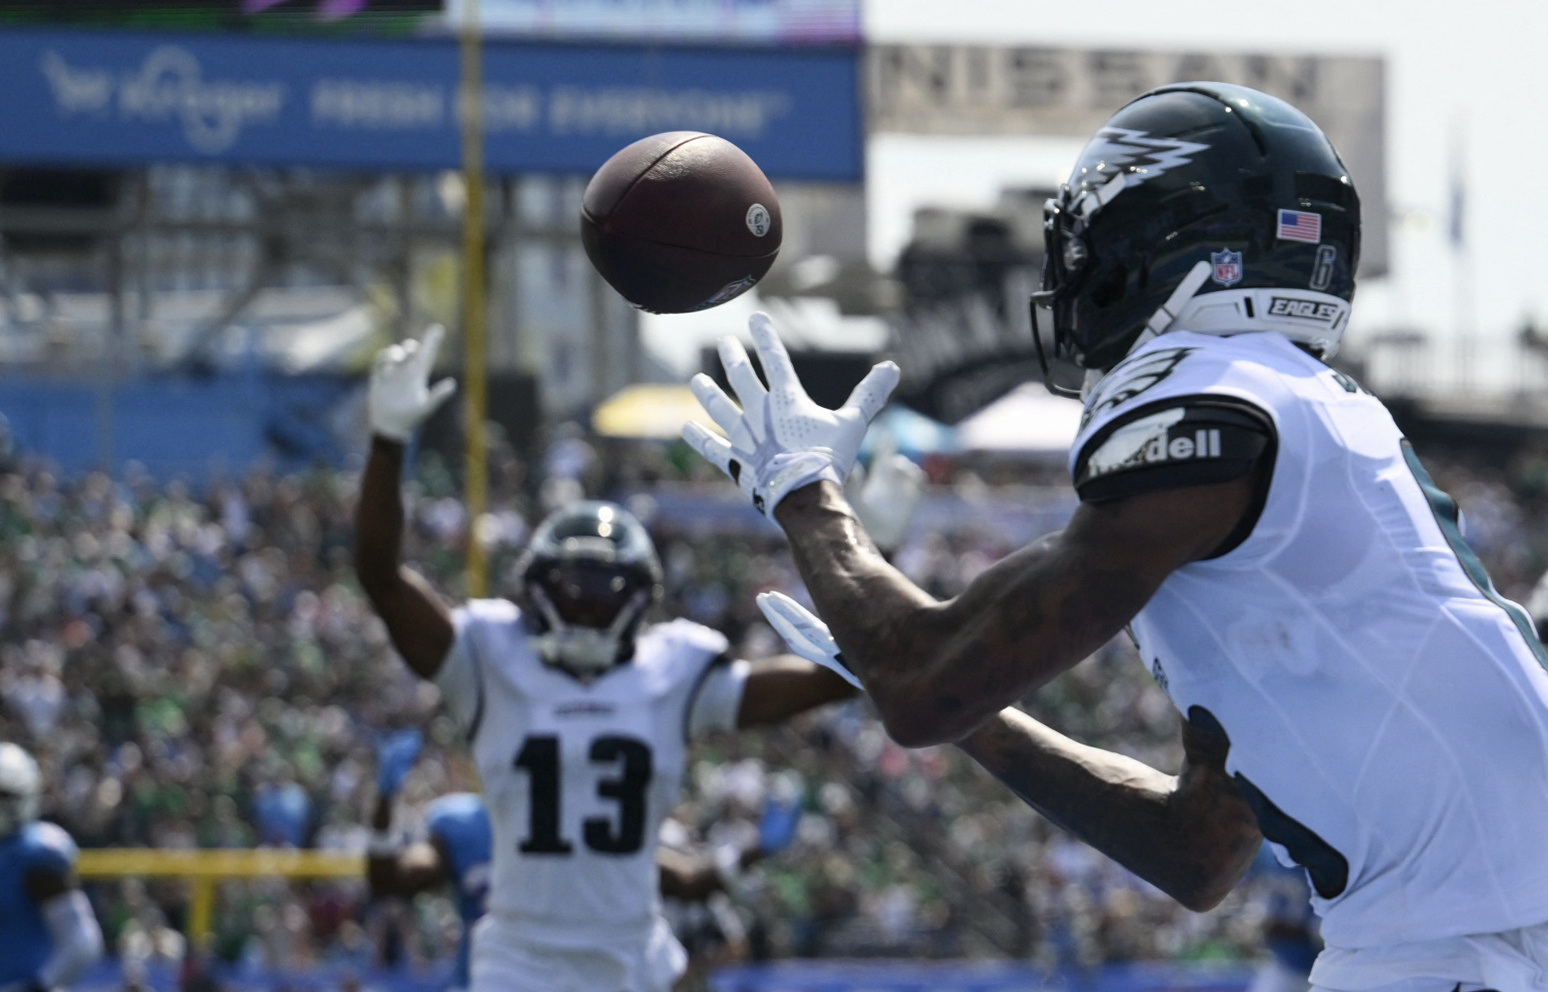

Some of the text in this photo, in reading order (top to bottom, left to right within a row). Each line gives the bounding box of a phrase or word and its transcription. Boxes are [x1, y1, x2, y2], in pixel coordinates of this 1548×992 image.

[881, 46, 1317, 107] NISSAN
[1309, 244, 1337, 291] 6
[1271, 299, 1338, 320] EAGLES
[513, 735, 655, 857] 13
